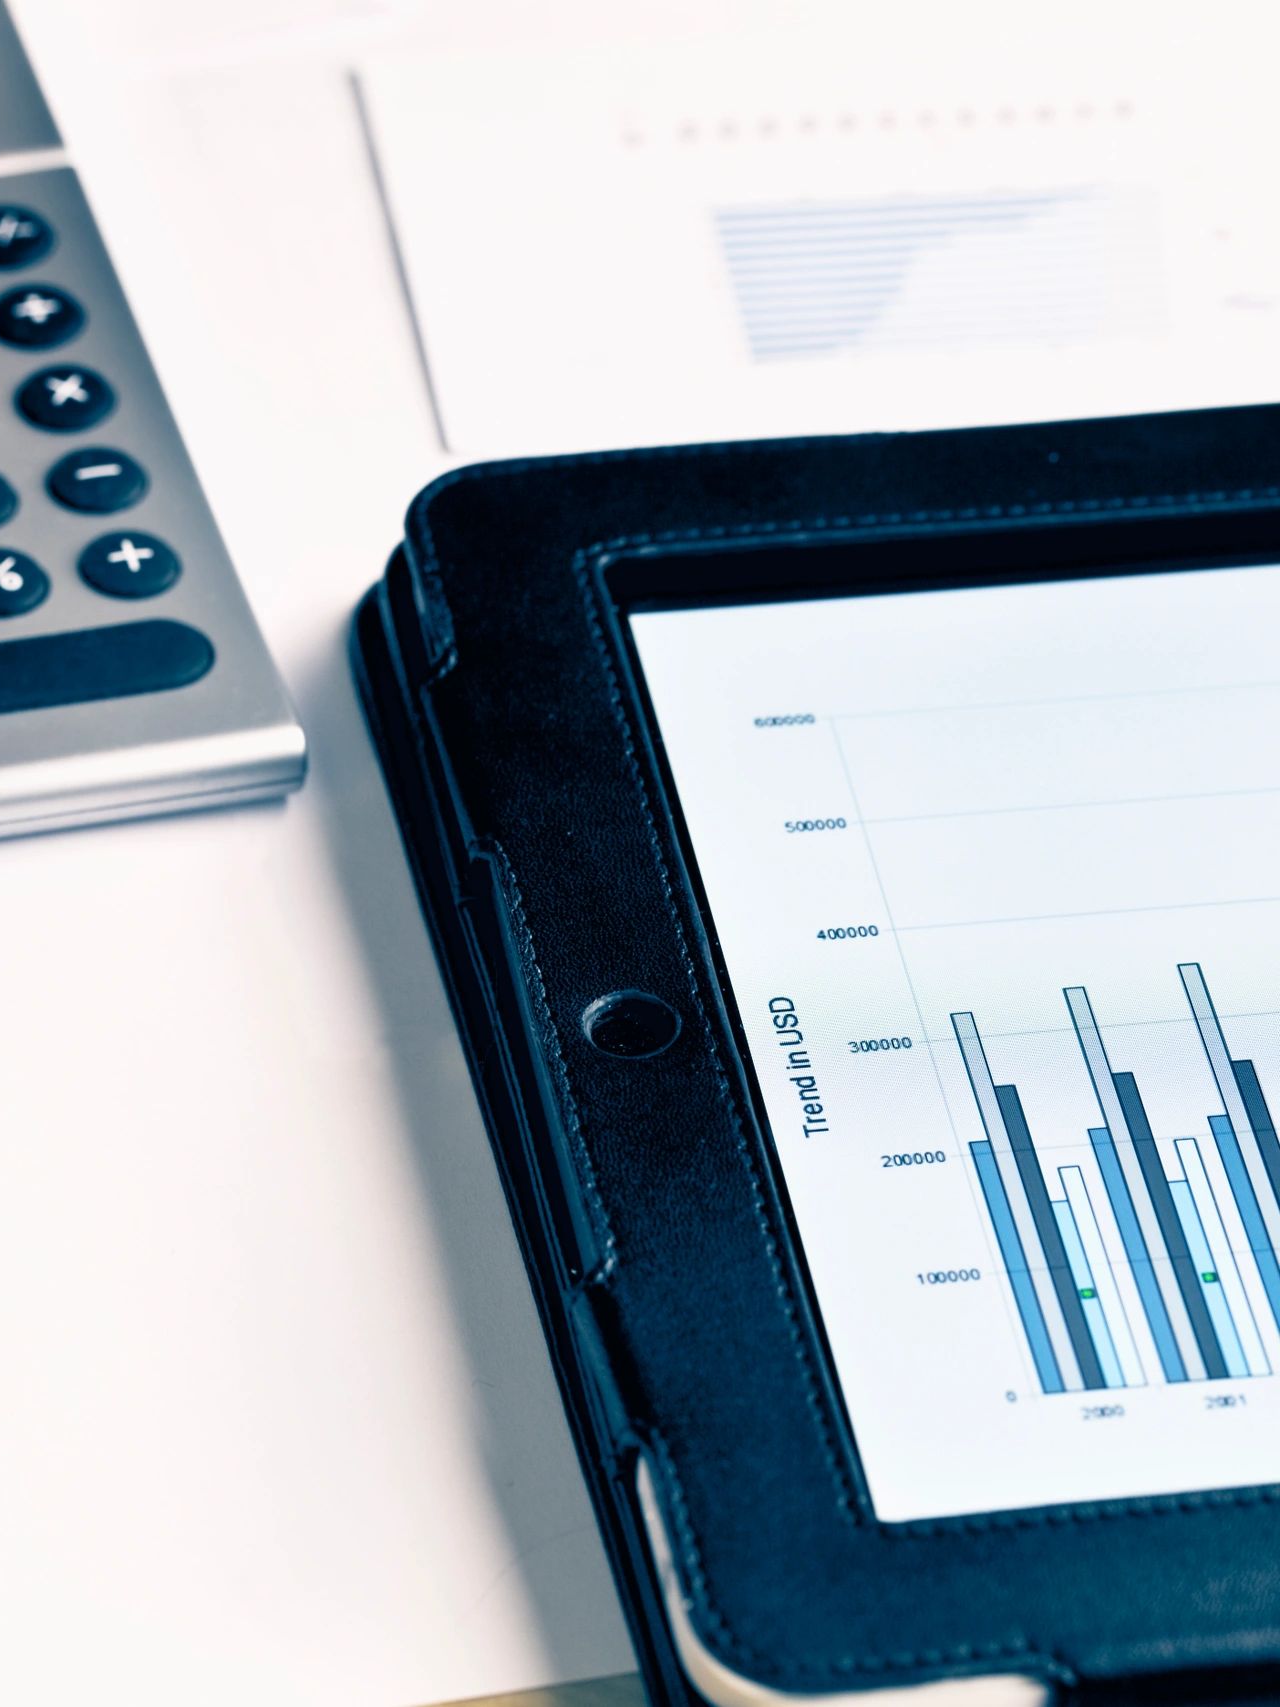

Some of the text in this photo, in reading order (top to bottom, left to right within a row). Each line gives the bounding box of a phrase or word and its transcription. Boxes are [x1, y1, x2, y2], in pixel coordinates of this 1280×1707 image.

[785, 818, 847, 833] 500000
[817, 925, 879, 940] 400000
[848, 1037, 912, 1053] 300000
[768, 997, 829, 1138] Trend in USD
[881, 1151, 946, 1167] 200000
[917, 1269, 980, 1284] 100000
